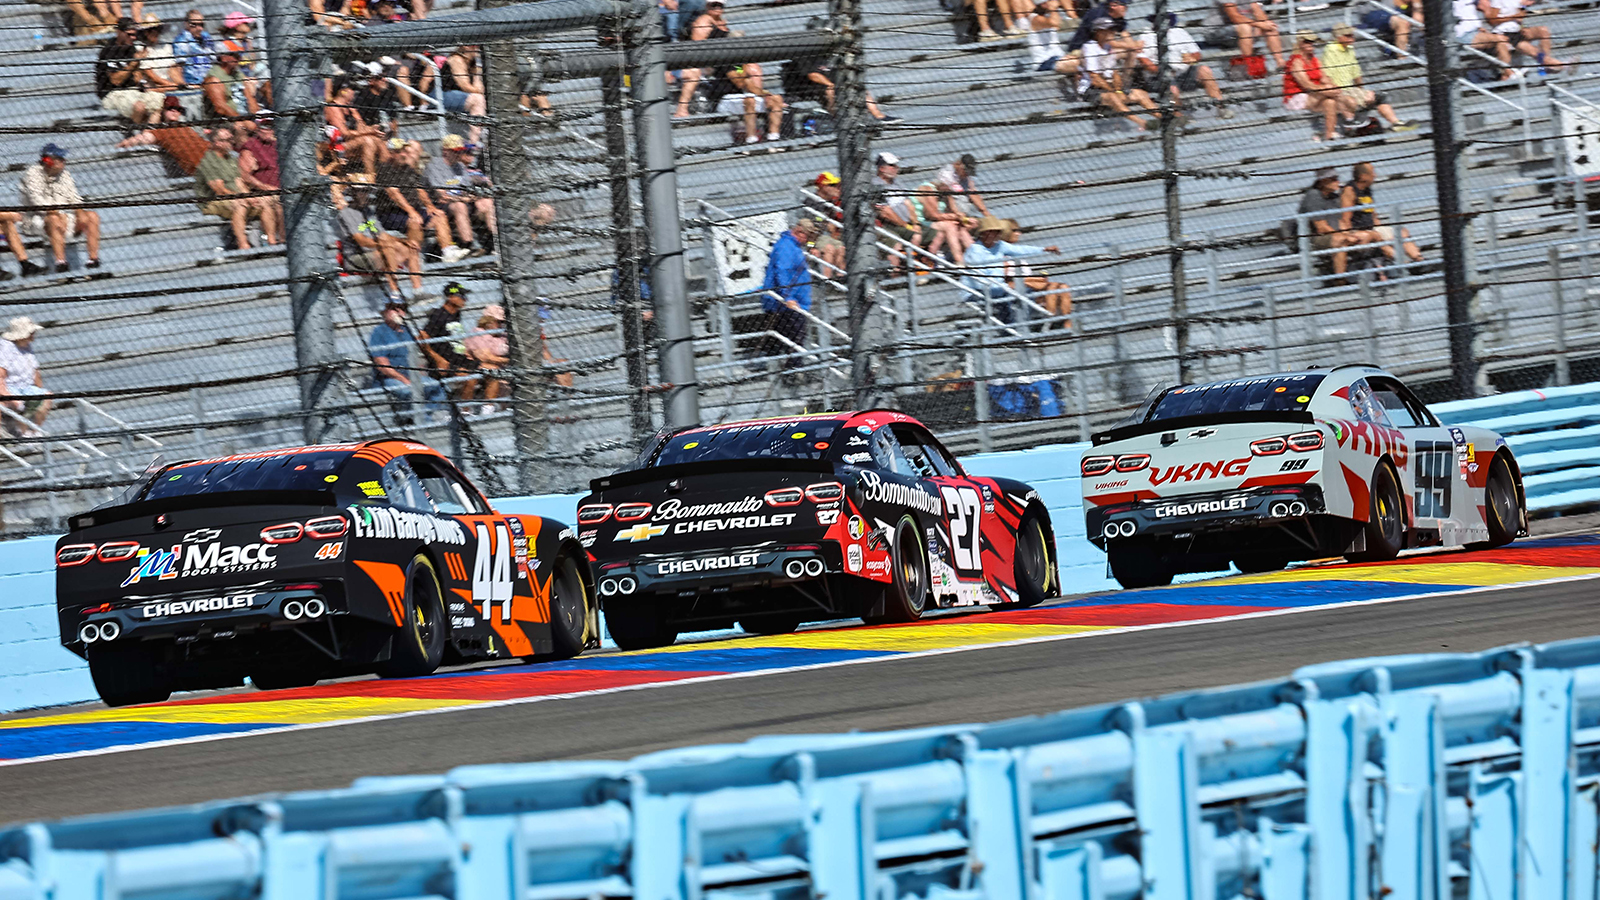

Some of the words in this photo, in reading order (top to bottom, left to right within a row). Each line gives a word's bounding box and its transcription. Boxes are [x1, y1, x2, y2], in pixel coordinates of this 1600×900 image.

[727, 422, 800, 433] BURTON
[1147, 455, 1255, 487] VKNG
[1278, 458, 1310, 472] 99
[1095, 479, 1129, 491] VIKING
[1414, 441, 1454, 518] 99
[650, 495, 765, 522] Bommarito
[816, 509, 841, 526] 27
[1155, 496, 1250, 518] CHEVROLET
[673, 513, 797, 535] CHEVROLET
[940, 486, 983, 571] 27
[182, 541, 279, 571] Macc
[313, 541, 344, 561] 44
[180, 565, 218, 579] DOOR
[222, 560, 278, 574] SYSTEMS
[472, 524, 514, 621] 44
[657, 553, 761, 575] CHEVROLET
[142, 593, 258, 618] CHEVROLET
